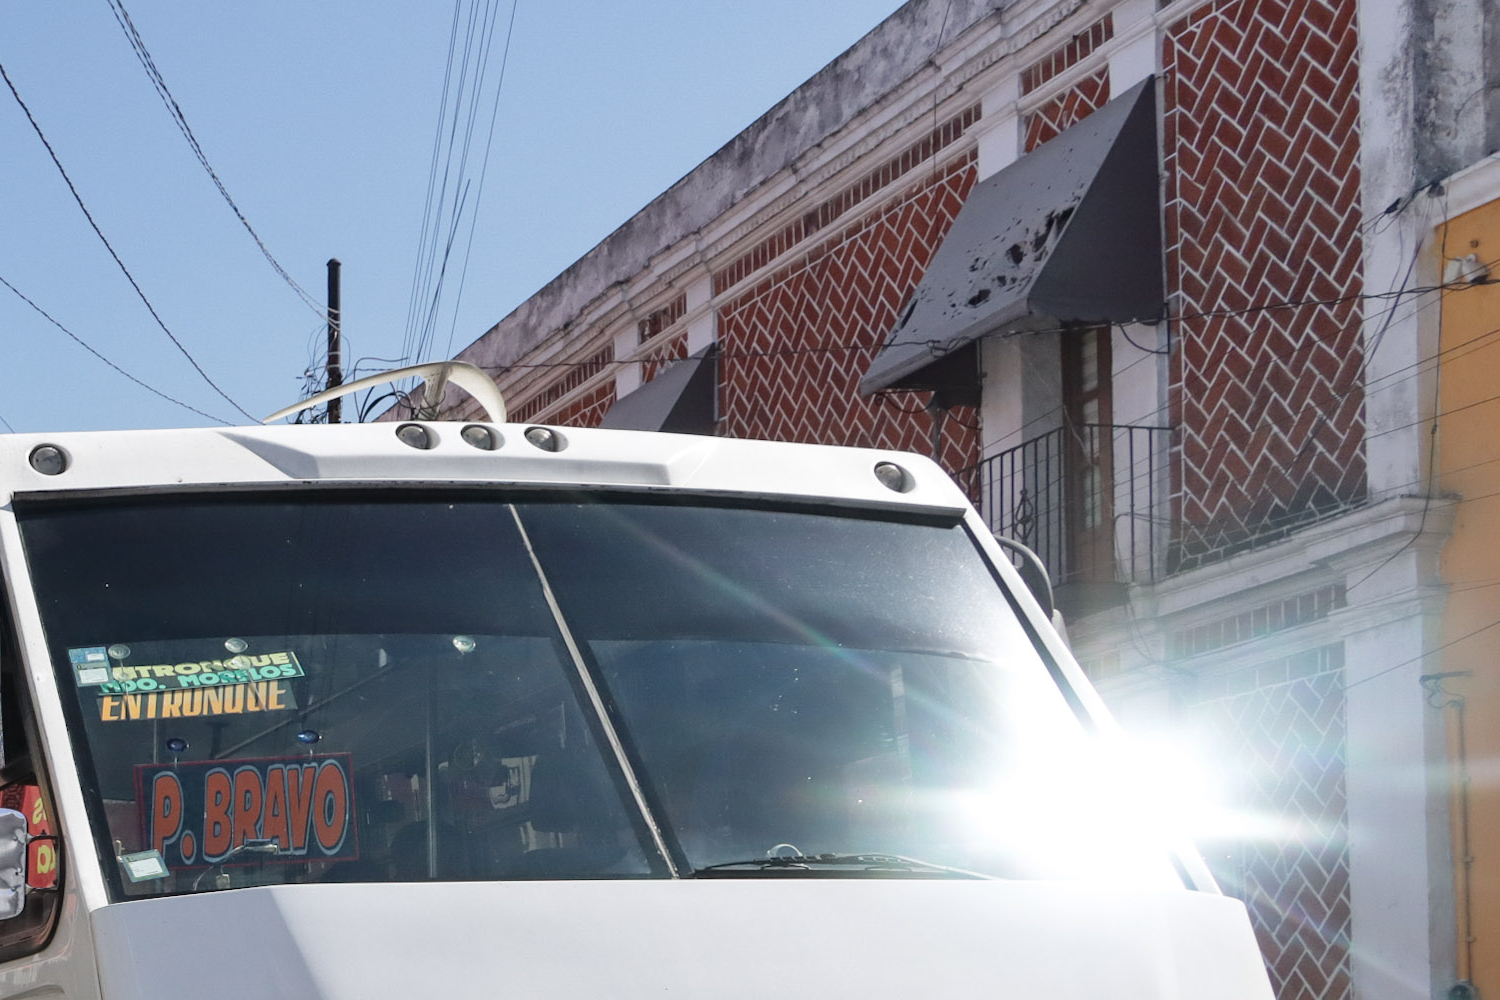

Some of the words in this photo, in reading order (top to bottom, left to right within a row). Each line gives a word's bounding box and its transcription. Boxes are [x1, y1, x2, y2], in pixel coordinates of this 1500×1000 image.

[178, 663, 297, 688] MORELOS
[151, 769, 197, 865] P.
[202, 758, 349, 863] BRAVO
